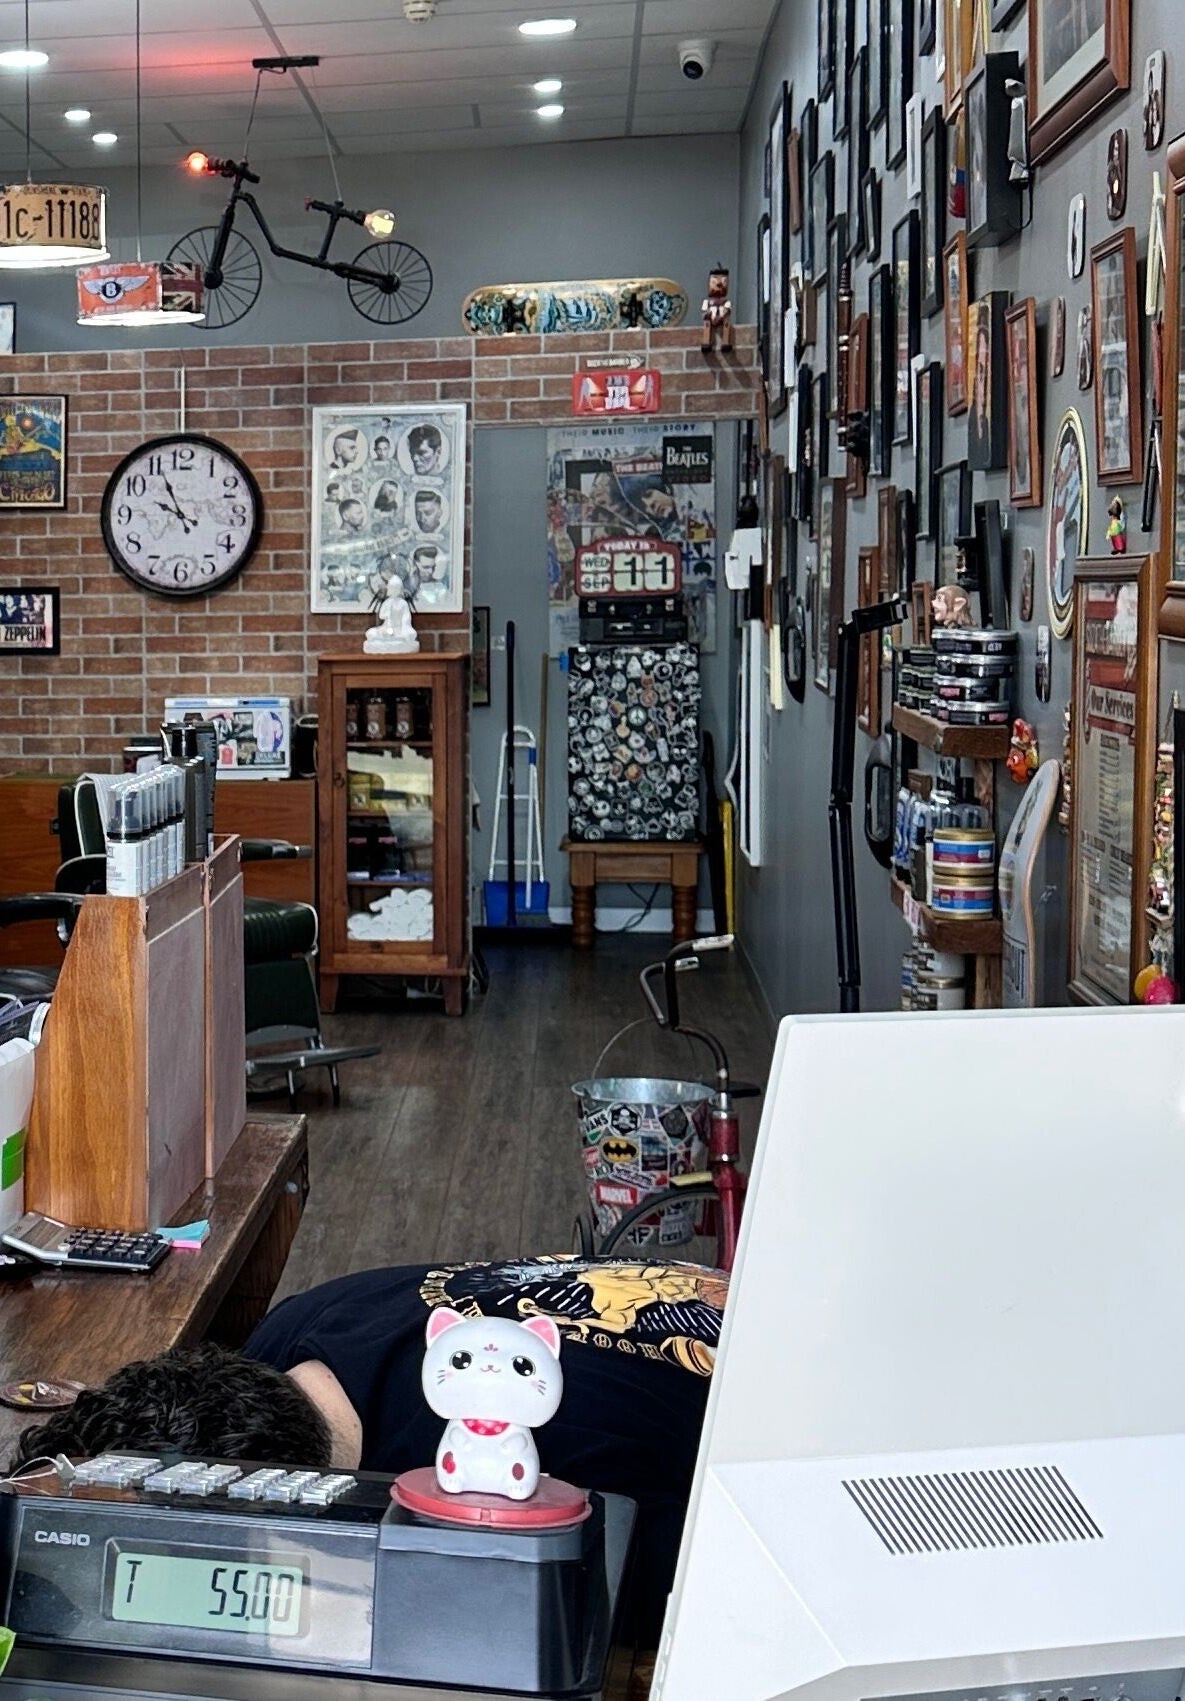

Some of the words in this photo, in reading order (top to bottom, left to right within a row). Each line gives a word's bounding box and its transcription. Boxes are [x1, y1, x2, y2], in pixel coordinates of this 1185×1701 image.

[592, 427, 625, 436] MUSIC
[663, 423, 696, 433] STORY
[148, 455, 162, 476] 11
[171, 449, 195, 471] 12
[208, 456, 216, 478] 1
[666, 446, 709, 469] BEATLES
[126, 475, 147, 497] 10
[223, 476, 239, 499] 2
[117, 504, 132, 526] 9
[230, 504, 246, 528] 3
[125, 532, 142, 554] 8
[216, 533, 236, 555] 4
[147, 555, 161, 576] 7
[173, 562, 189, 584] 6
[200, 554, 216, 576] 5
[584, 557, 609, 568] WED
[4, 626, 46, 641] ZEPPELIN
[34, 1530, 90, 1546] CASIO
[126, 1560, 143, 1603] T
[208, 1567, 295, 1623] 55.00
